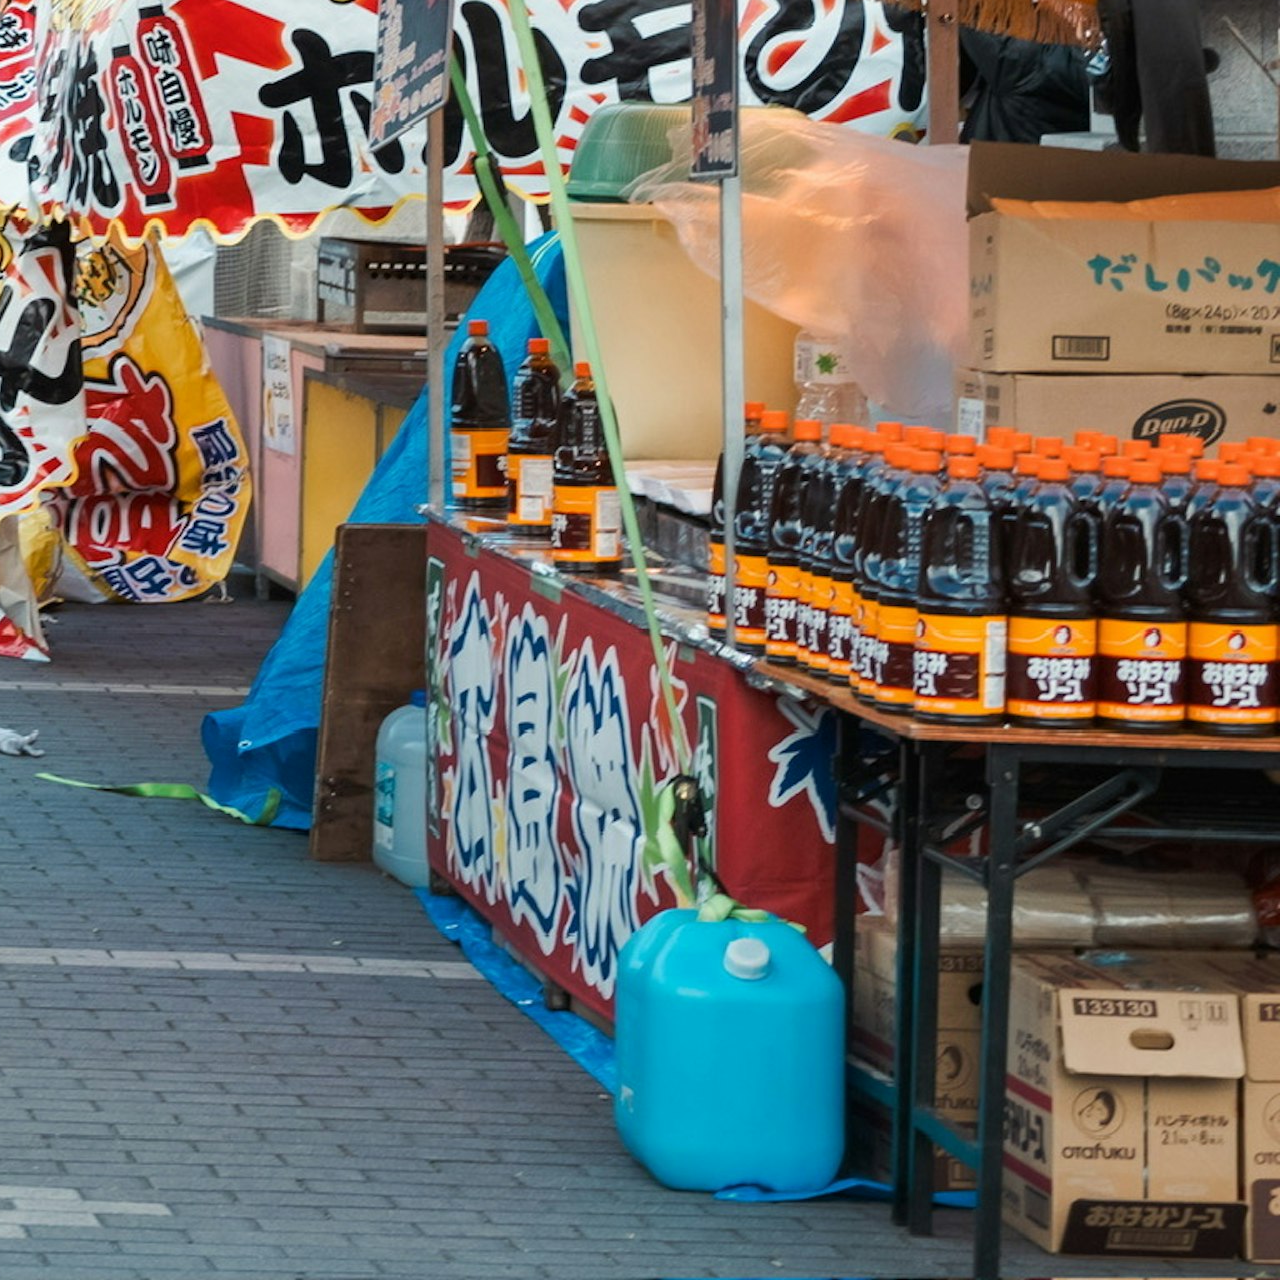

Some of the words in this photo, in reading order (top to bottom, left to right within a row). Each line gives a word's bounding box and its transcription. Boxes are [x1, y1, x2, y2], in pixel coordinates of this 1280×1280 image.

[146, 28, 200, 149] 味自慢
[118, 70, 159, 182] ホルモン
[1038, 678, 1083, 702] ソース
[1126, 681, 1173, 705] ソース
[1211, 684, 1261, 707] ソース
[1077, 999, 1154, 1017] 133130
[1085, 1206, 1227, 1230] お好みソース
